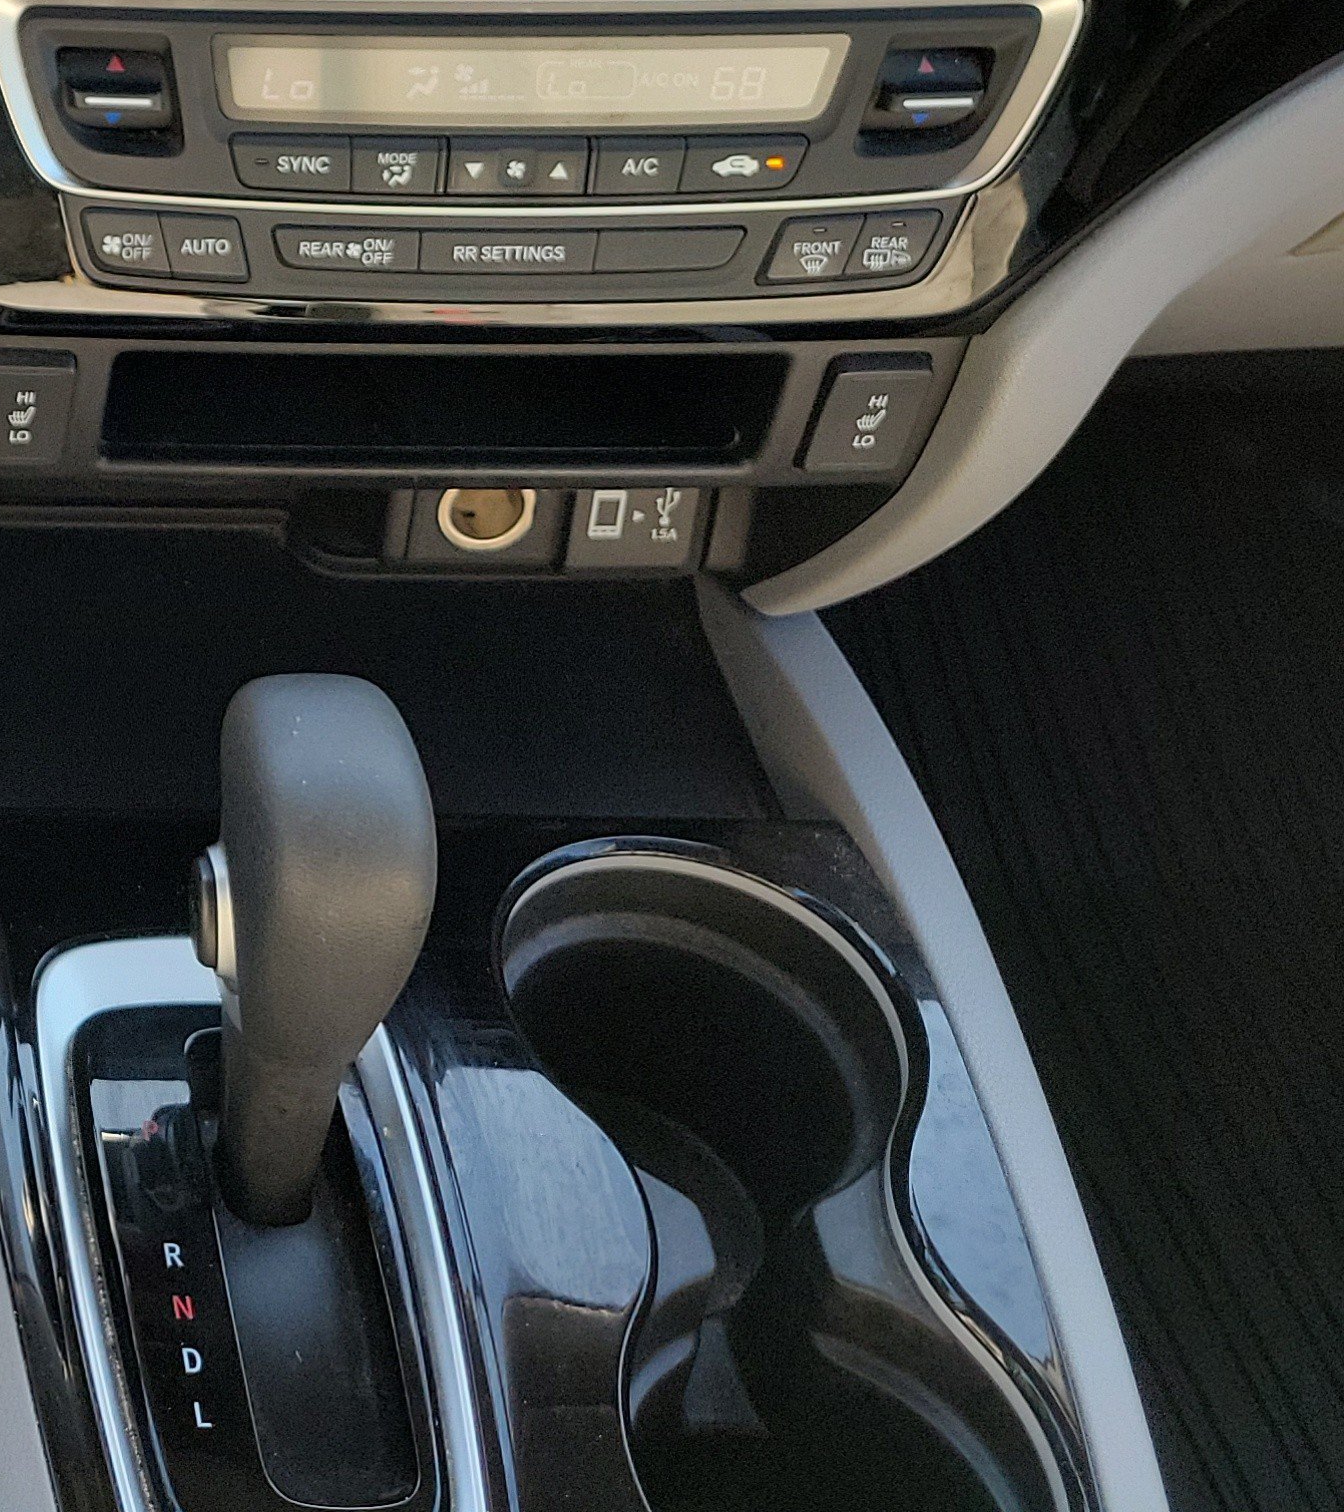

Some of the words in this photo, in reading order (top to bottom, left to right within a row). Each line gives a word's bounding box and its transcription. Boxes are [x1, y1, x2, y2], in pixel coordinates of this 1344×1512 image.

[276, 156, 330, 175] SYNC
[378, 152, 417, 165] MODE
[621, 157, 660, 177] A/C
[122, 233, 153, 247] ON/
[181, 239, 230, 256] AUTO
[363, 238, 394, 252] ON/
[793, 240, 842, 256] FRONT
[872, 236, 909, 250] REAR
[122, 247, 152, 261] OFF
[298, 242, 344, 258] REAR
[453, 245, 477, 263] RR
[480, 245, 566, 263] SETTINGS
[362, 252, 394, 266] OFF
[16, 391, 37, 405] HI
[868, 393, 889, 409] HI
[9, 429, 33, 445] LO
[852, 434, 876, 449] LO
[164, 1242, 185, 1270] R
[172, 1295, 195, 1321] N
[184, 1347, 202, 1374] D
[194, 1401, 212, 1429] L
